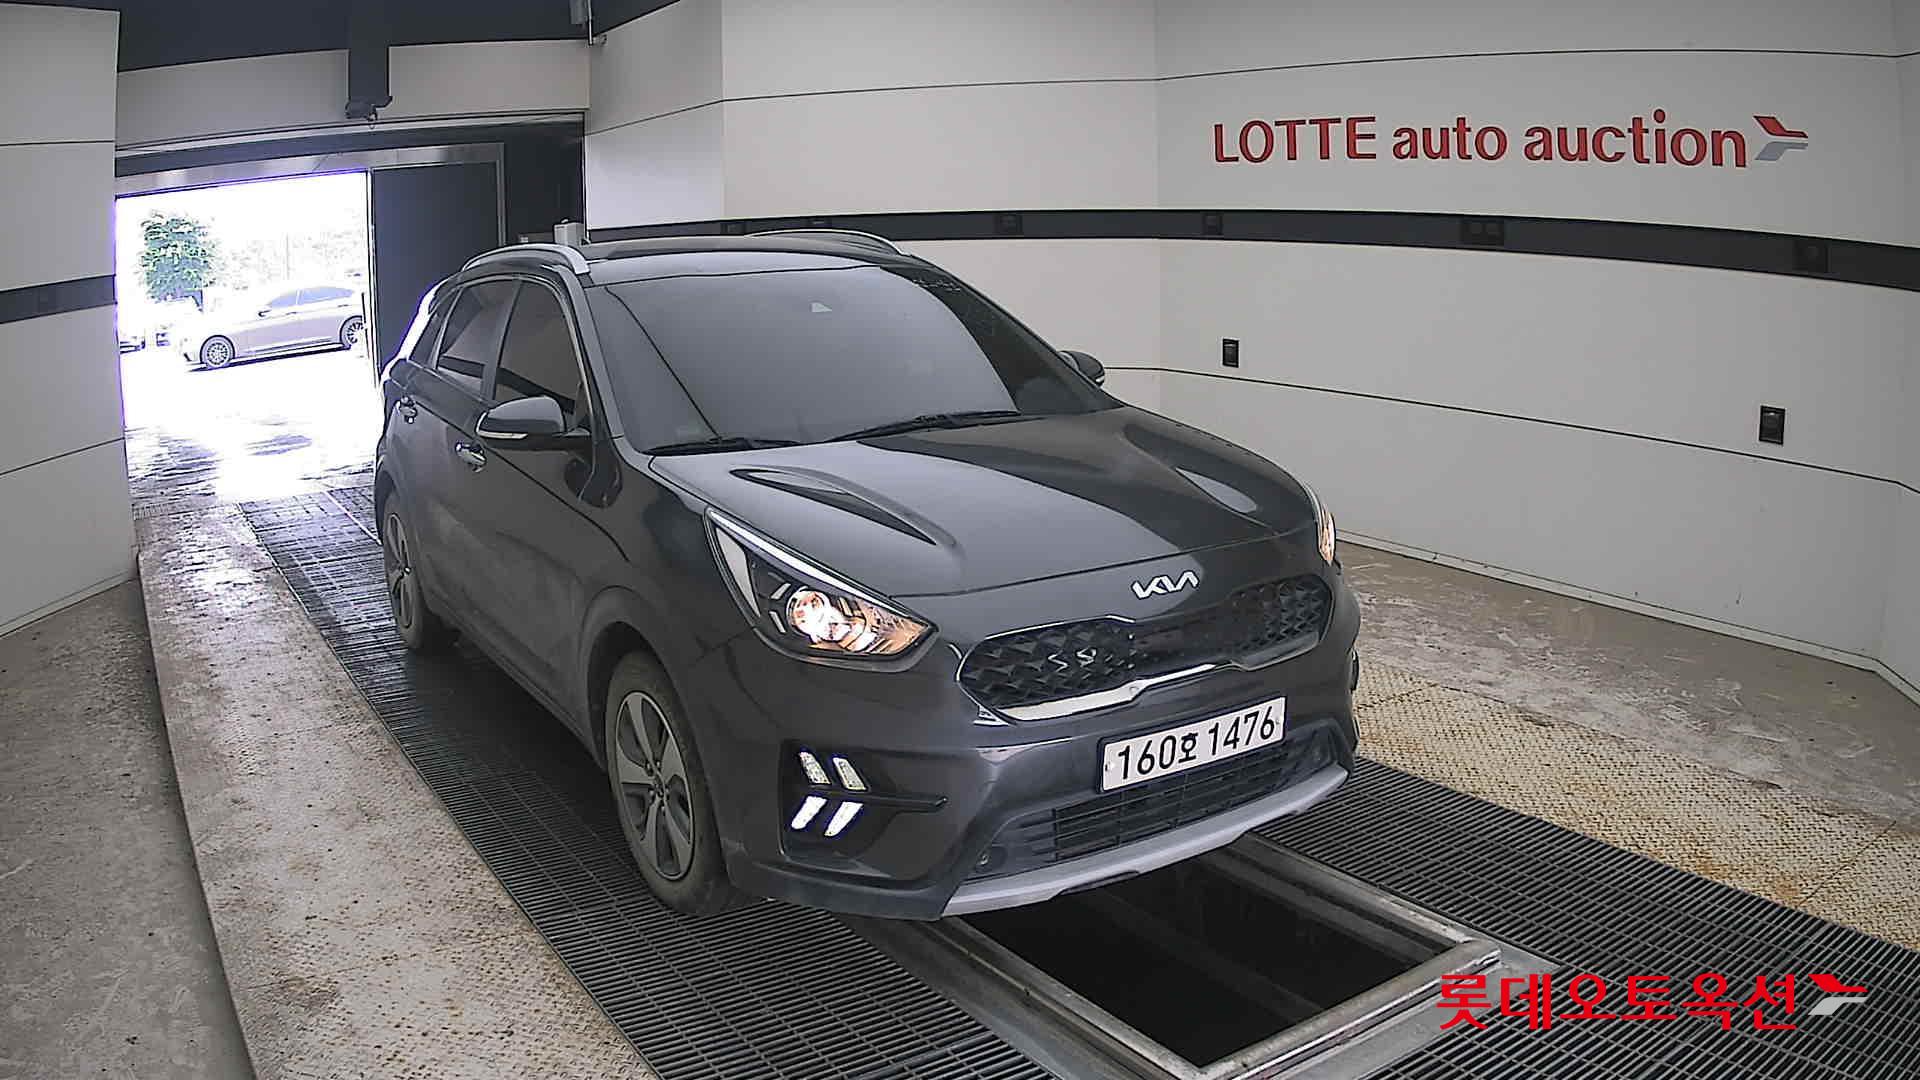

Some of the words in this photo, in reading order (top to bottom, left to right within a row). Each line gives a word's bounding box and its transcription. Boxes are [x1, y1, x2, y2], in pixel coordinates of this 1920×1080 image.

[1213, 116, 1377, 164] LOTTE
[1392, 116, 1508, 161] auto
[1523, 109, 1747, 168] auction
[1132, 571, 1199, 599] KIA
[1117, 732, 1199, 780] 160호
[1208, 705, 1276, 756] 1476
